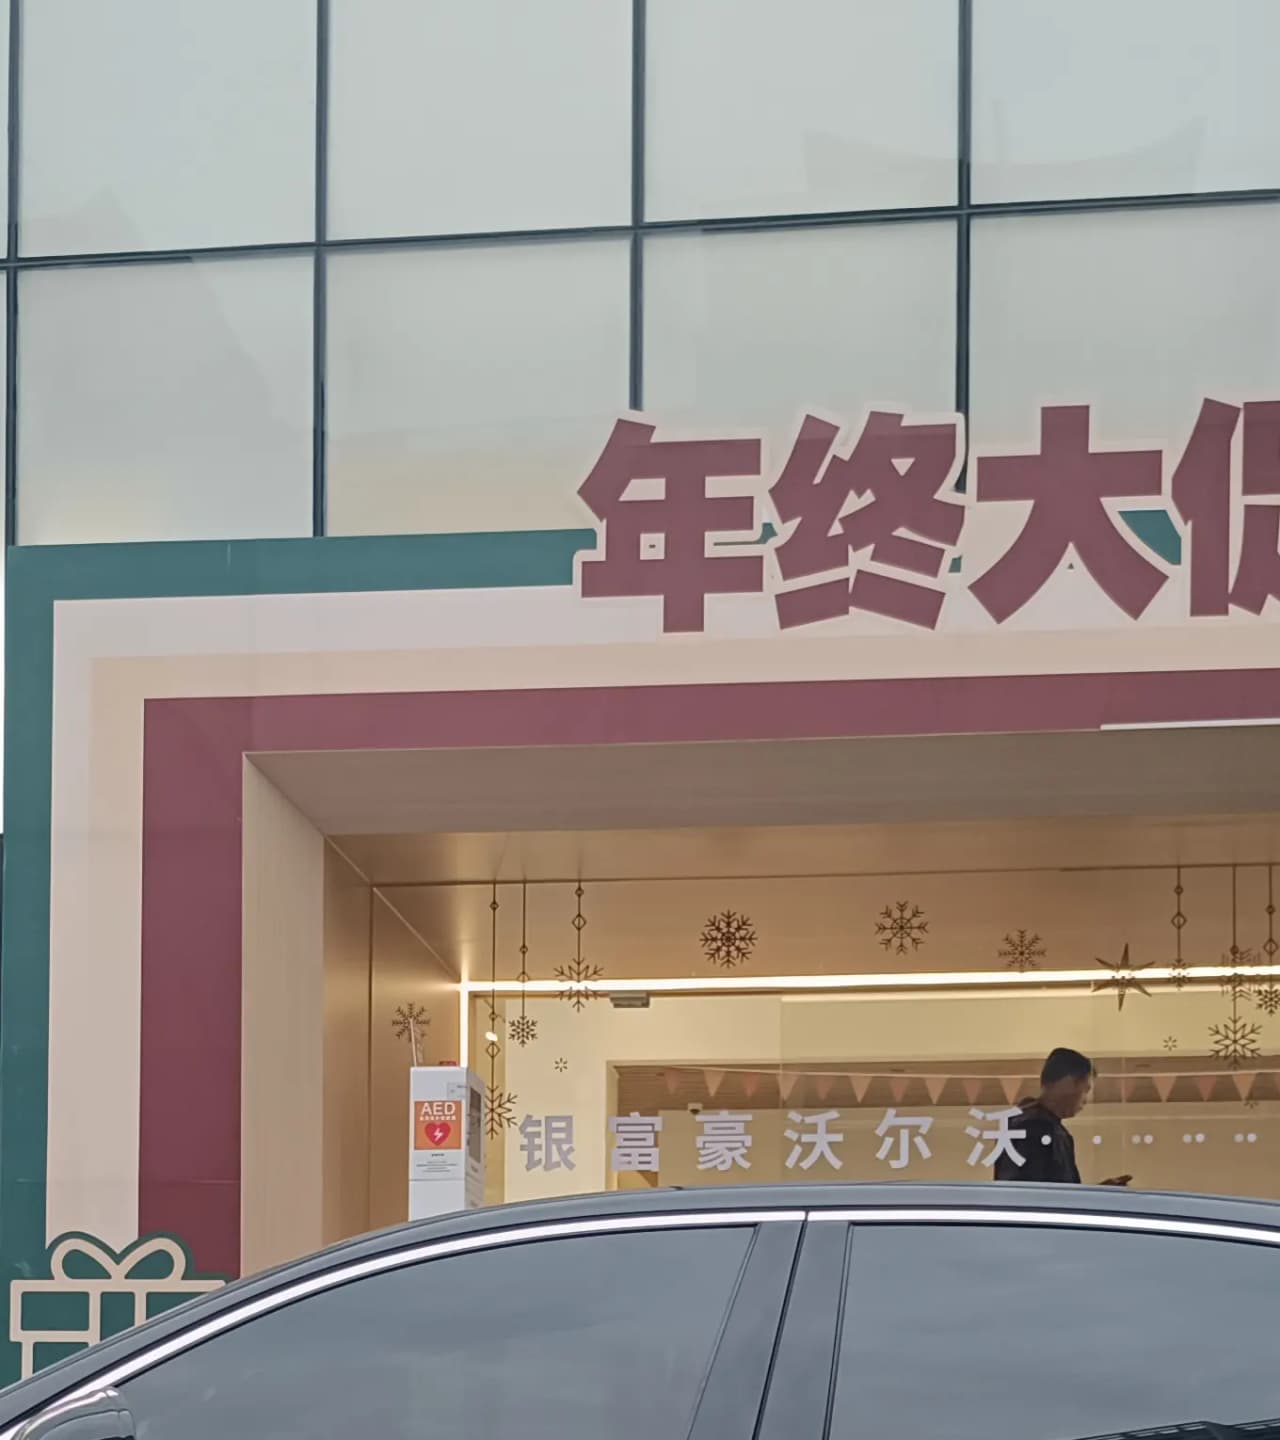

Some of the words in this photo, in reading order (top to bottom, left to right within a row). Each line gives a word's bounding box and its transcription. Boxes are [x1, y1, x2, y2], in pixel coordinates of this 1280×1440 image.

[421, 1102, 456, 1115] AED
[520, 1107, 1027, 1173] 银富豪沃尔沃
